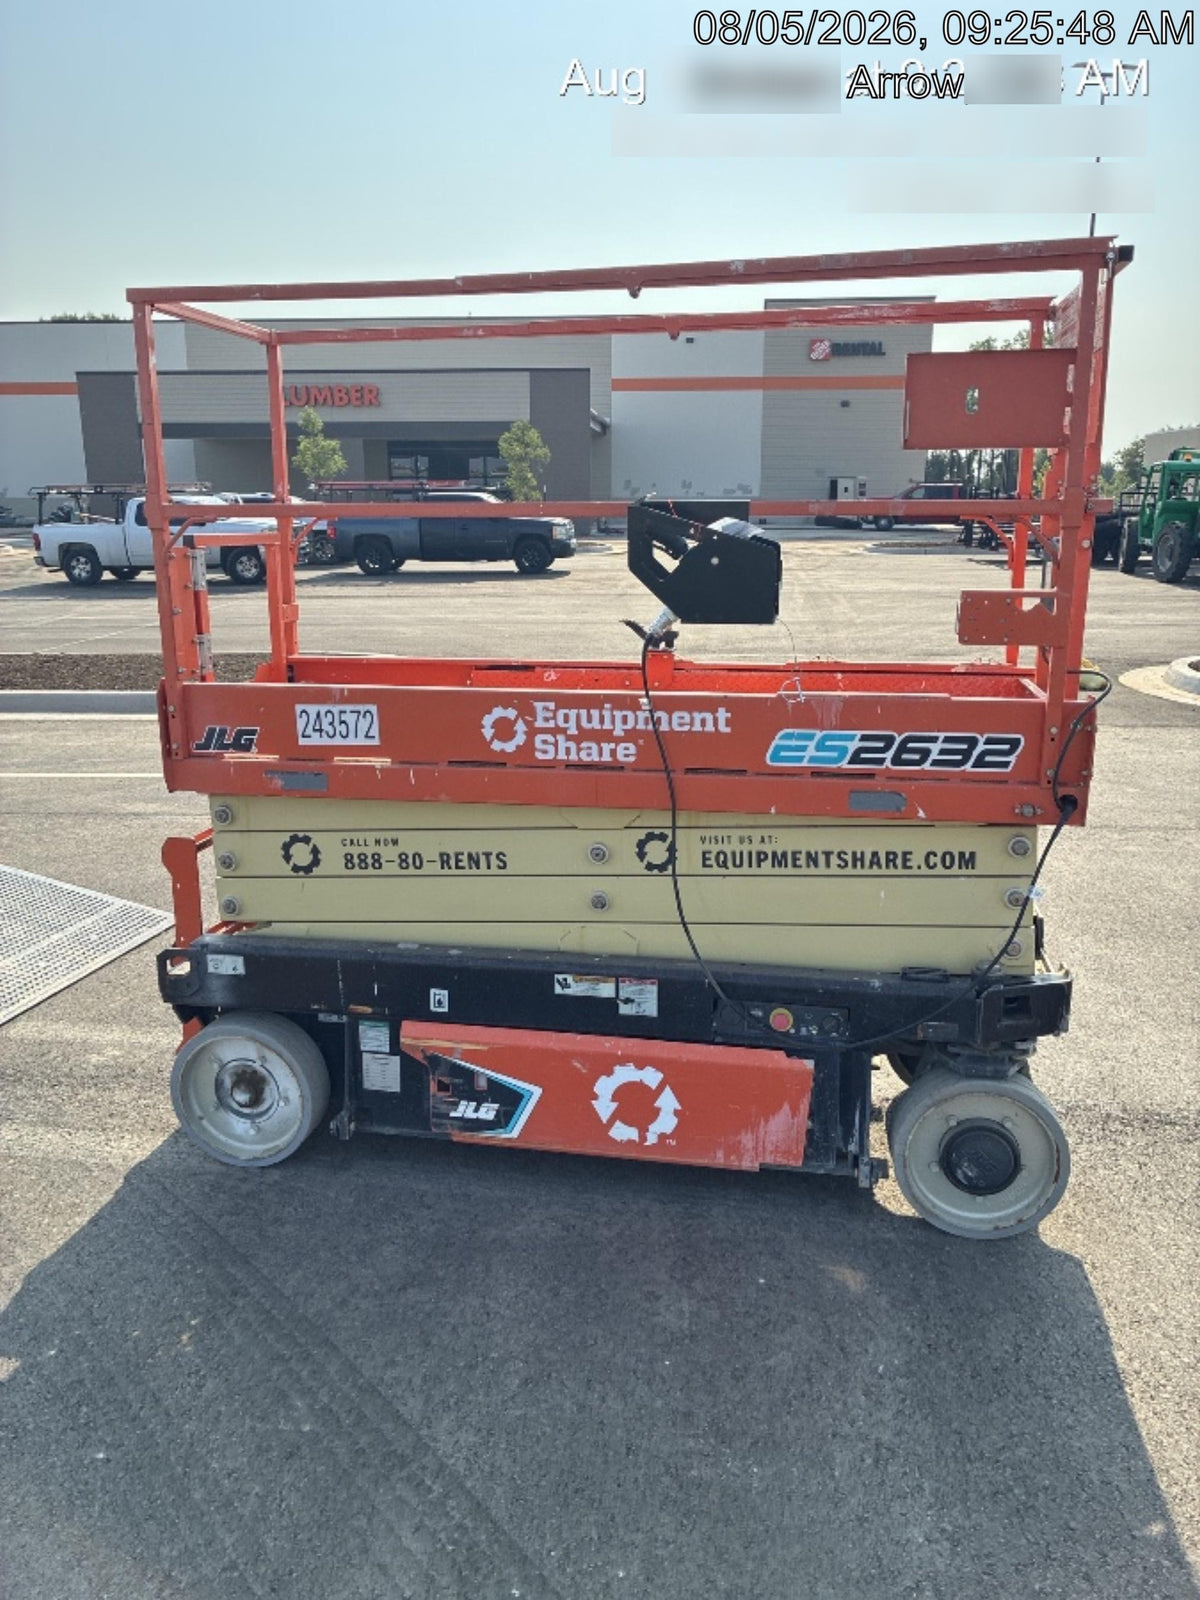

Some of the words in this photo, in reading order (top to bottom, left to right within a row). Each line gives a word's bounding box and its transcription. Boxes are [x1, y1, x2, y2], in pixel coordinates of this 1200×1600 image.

[300, 709, 376, 739] 243572
[534, 702, 731, 736] Equipment
[192, 726, 260, 753] JLG
[534, 734, 637, 762] Share
[766, 728, 1024, 772] ES2632
[341, 838, 370, 847] CALL
[374, 838, 399, 847] NOW
[700, 835, 732, 845] VISIT
[739, 835, 753, 845] US
[759, 835, 778, 845] AT:
[343, 851, 508, 870] 888-80-RENTS
[701, 850, 977, 870] EQUIPMENTSHARE.COM
[449, 1100, 499, 1121] JLG
